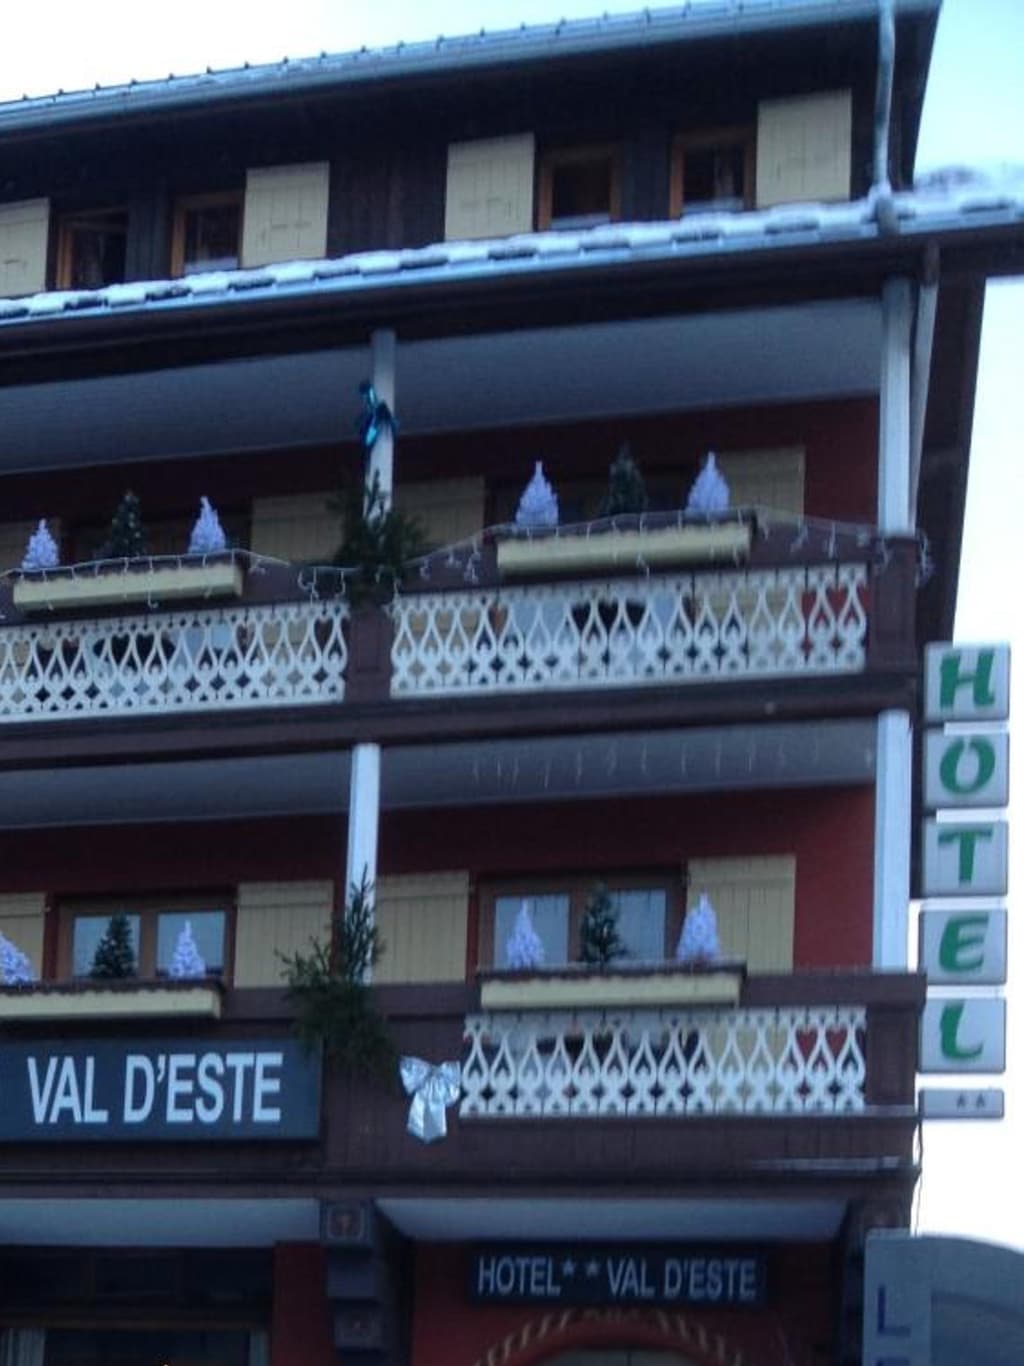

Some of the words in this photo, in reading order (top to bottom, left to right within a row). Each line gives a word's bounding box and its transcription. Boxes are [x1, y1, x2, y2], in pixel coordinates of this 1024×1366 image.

[938, 650, 996, 1061] HOTEL
[28, 1056, 108, 1124] VAL
[124, 1052, 283, 1122] D'ESTE
[478, 1256, 561, 1296] HOTEL
[606, 1258, 655, 1298] VAL
[664, 1258, 757, 1299] D'ESTE
